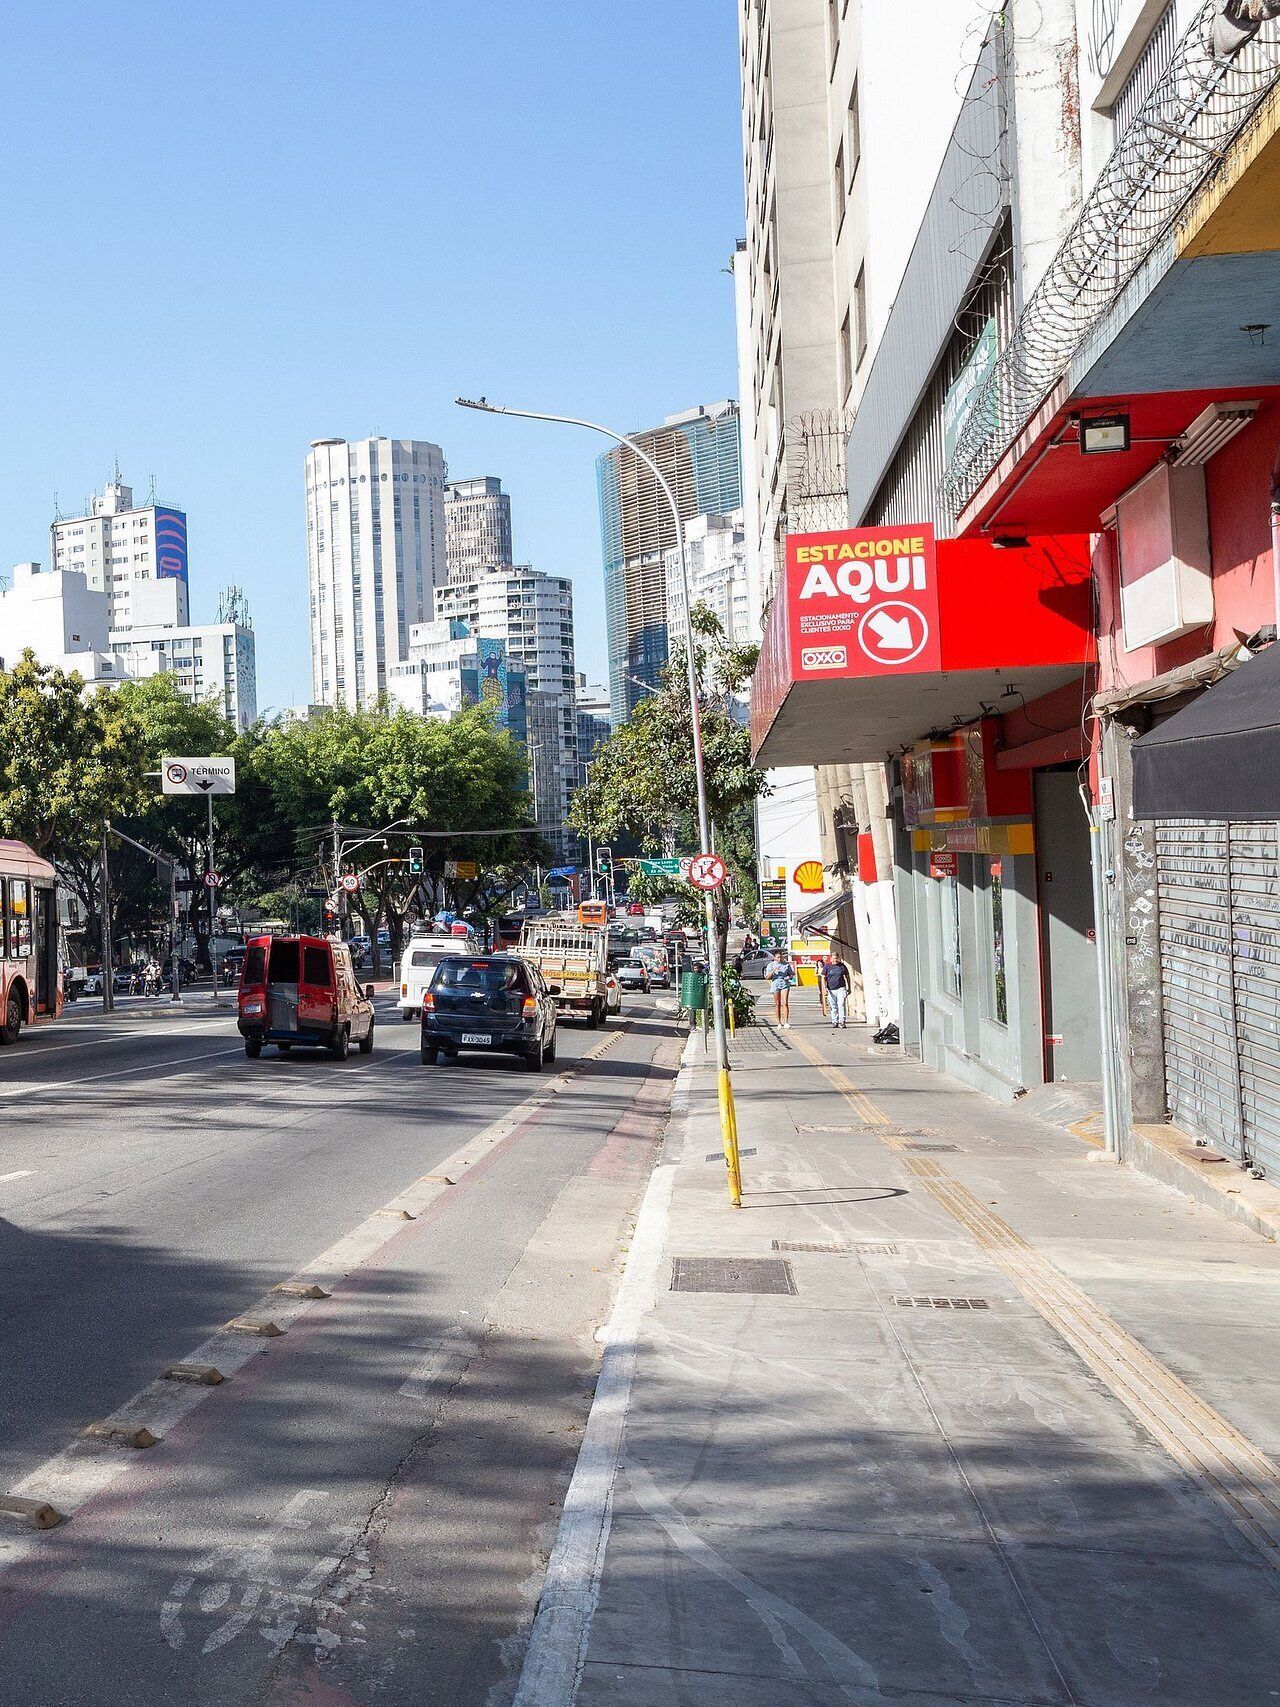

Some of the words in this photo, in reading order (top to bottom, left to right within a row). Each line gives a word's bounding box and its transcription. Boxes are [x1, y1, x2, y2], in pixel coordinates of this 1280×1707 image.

[796, 537, 925, 563] ESTACIONE
[799, 556, 927, 604] AQUI
[800, 612, 859, 622] ESTACIONAMENTO
[801, 620, 836, 628] EXCLUSIVO
[804, 651, 845, 665] OXXO
[345, 878, 355, 886] 50
